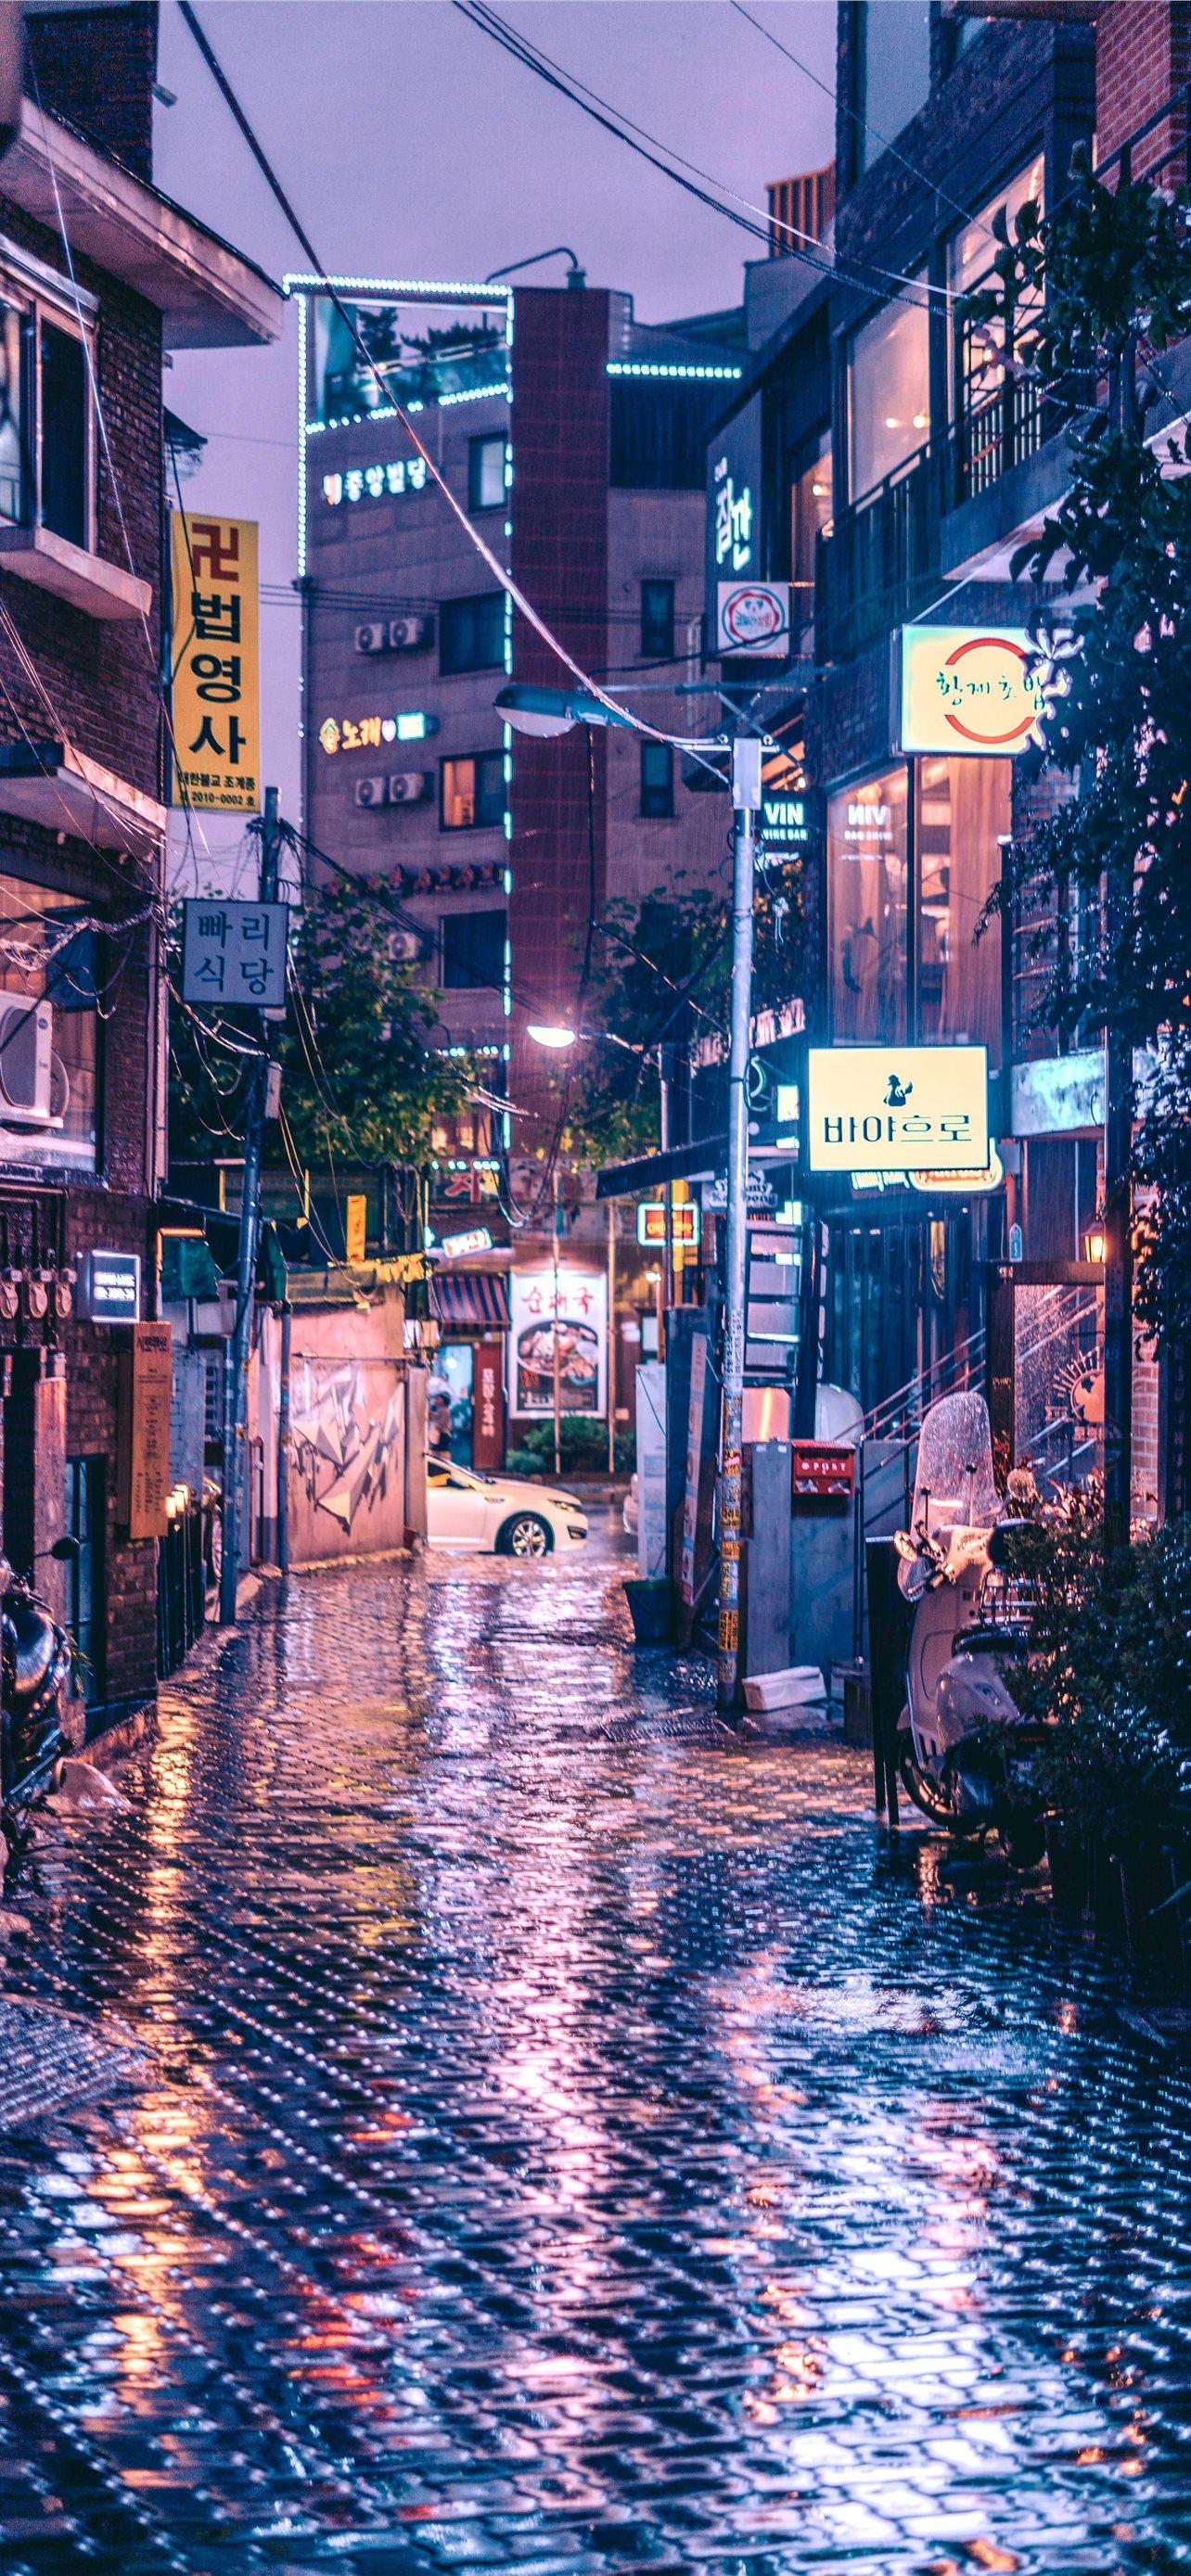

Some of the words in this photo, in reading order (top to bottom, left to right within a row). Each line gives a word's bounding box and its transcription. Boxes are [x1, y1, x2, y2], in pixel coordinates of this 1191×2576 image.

[189, 591, 247, 764] 법영사
[763, 802, 804, 826] VIN
[198, 911, 270, 951] 빠리
[194, 954, 275, 996] 식당
[824, 1115, 972, 1143] 바야흐로
